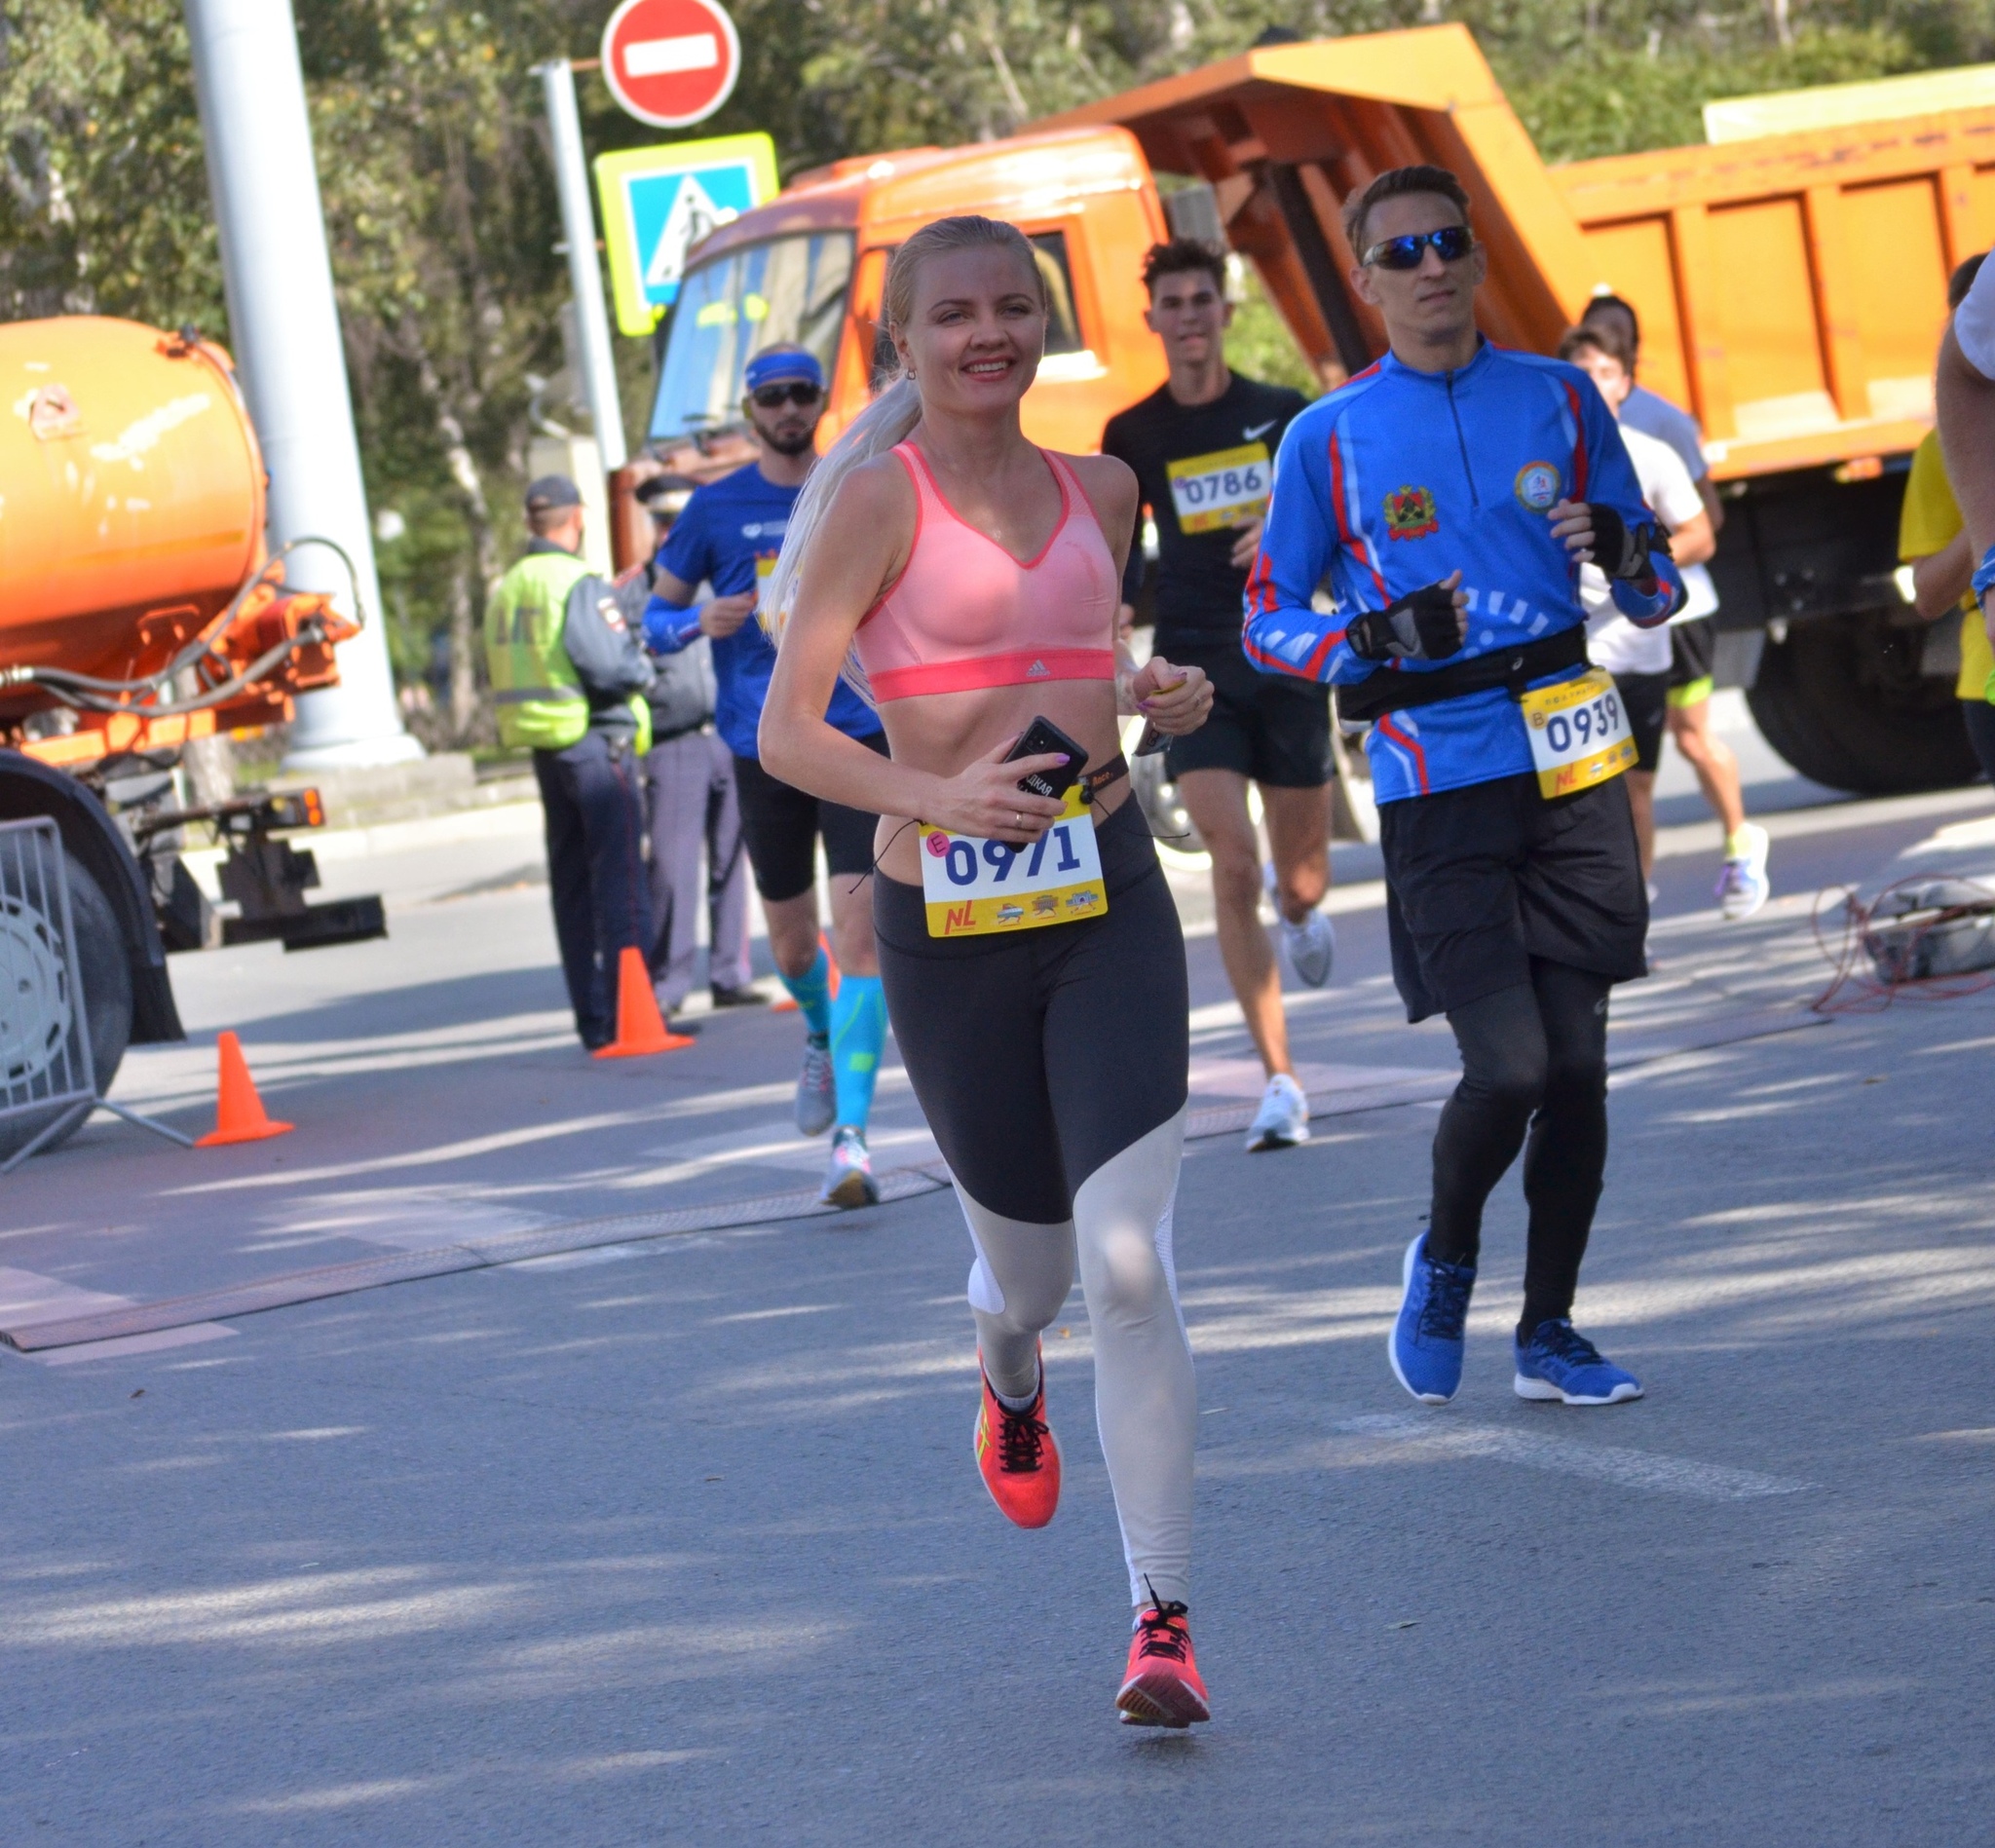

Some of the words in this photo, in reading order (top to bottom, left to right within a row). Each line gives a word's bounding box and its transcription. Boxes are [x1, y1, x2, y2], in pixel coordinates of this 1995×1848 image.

[1185, 466, 1261, 504] 0786
[1547, 693, 1619, 752] 0939
[1026, 773, 1053, 797] ДКАЯ
[930, 834, 948, 853] E
[945, 825, 1081, 886] 0971
[944, 899, 977, 935] NL
